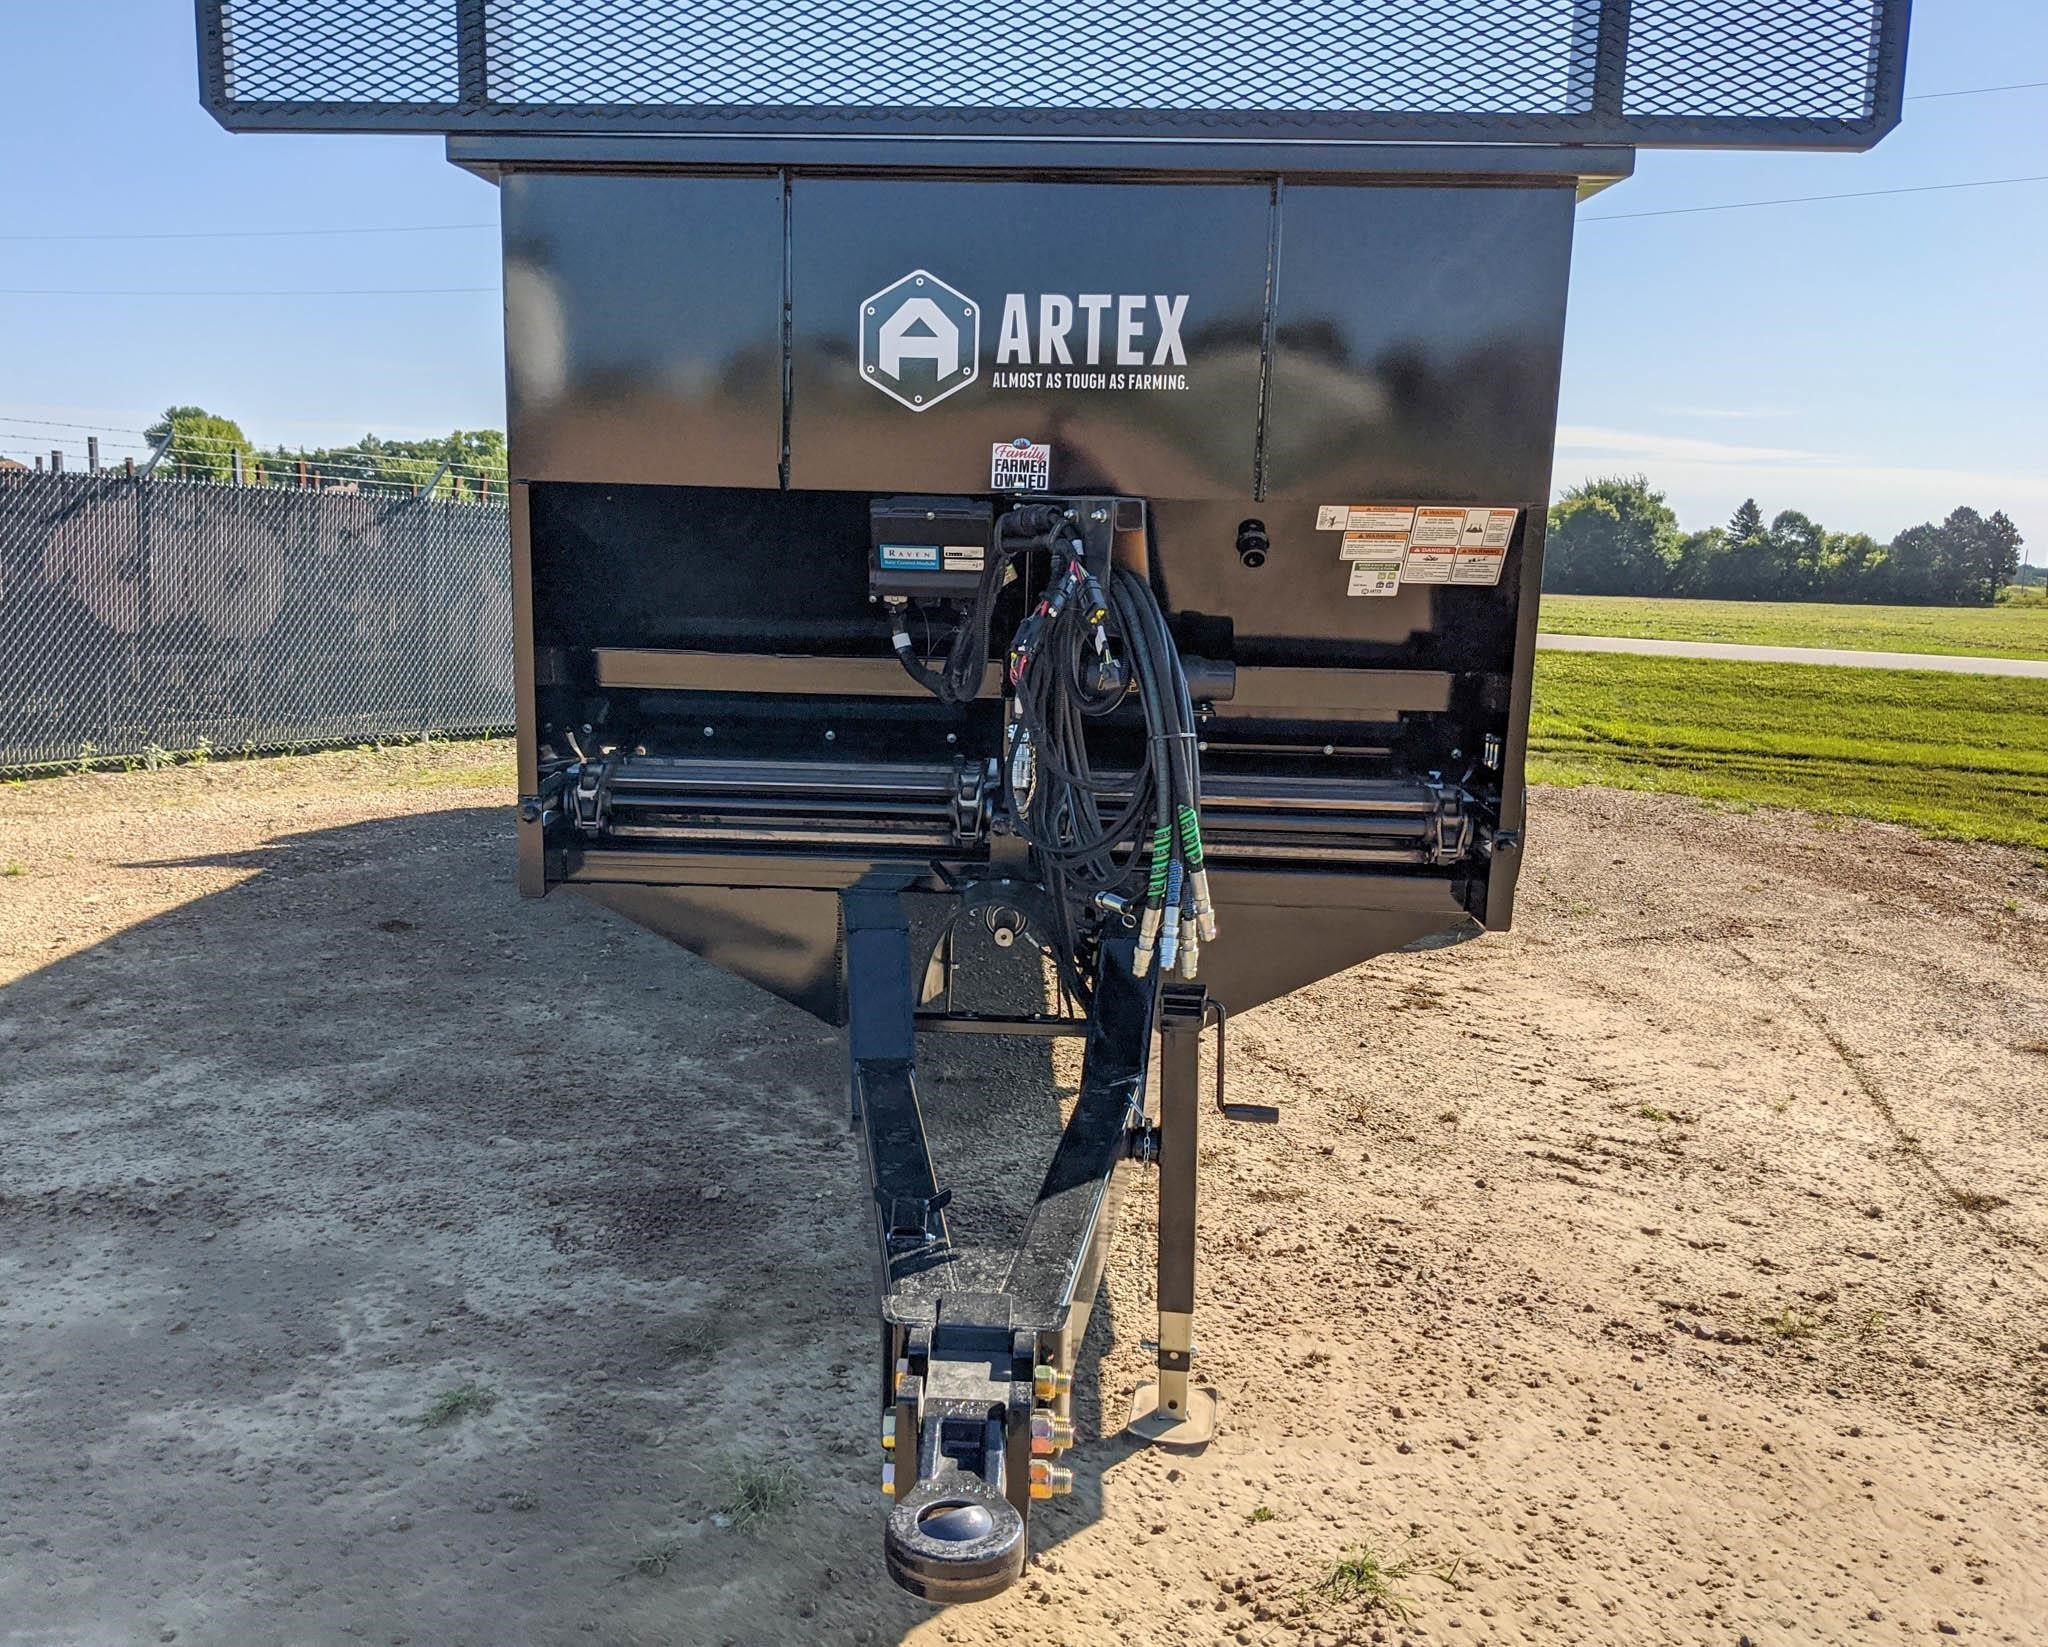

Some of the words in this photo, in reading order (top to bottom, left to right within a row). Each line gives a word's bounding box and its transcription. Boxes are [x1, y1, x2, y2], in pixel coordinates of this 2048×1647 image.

[996, 293, 1190, 366] ARTEX
[992, 372, 1043, 389] ALMOST
[1046, 372, 1062, 389] AS
[1065, 373, 1106, 390] TOUGH
[1109, 373, 1125, 390] AS
[1128, 374, 1189, 391] FARMING.
[995, 445, 1047, 464] Family
[995, 458, 1046, 474] FARMER
[994, 473, 1046, 489] OWNED
